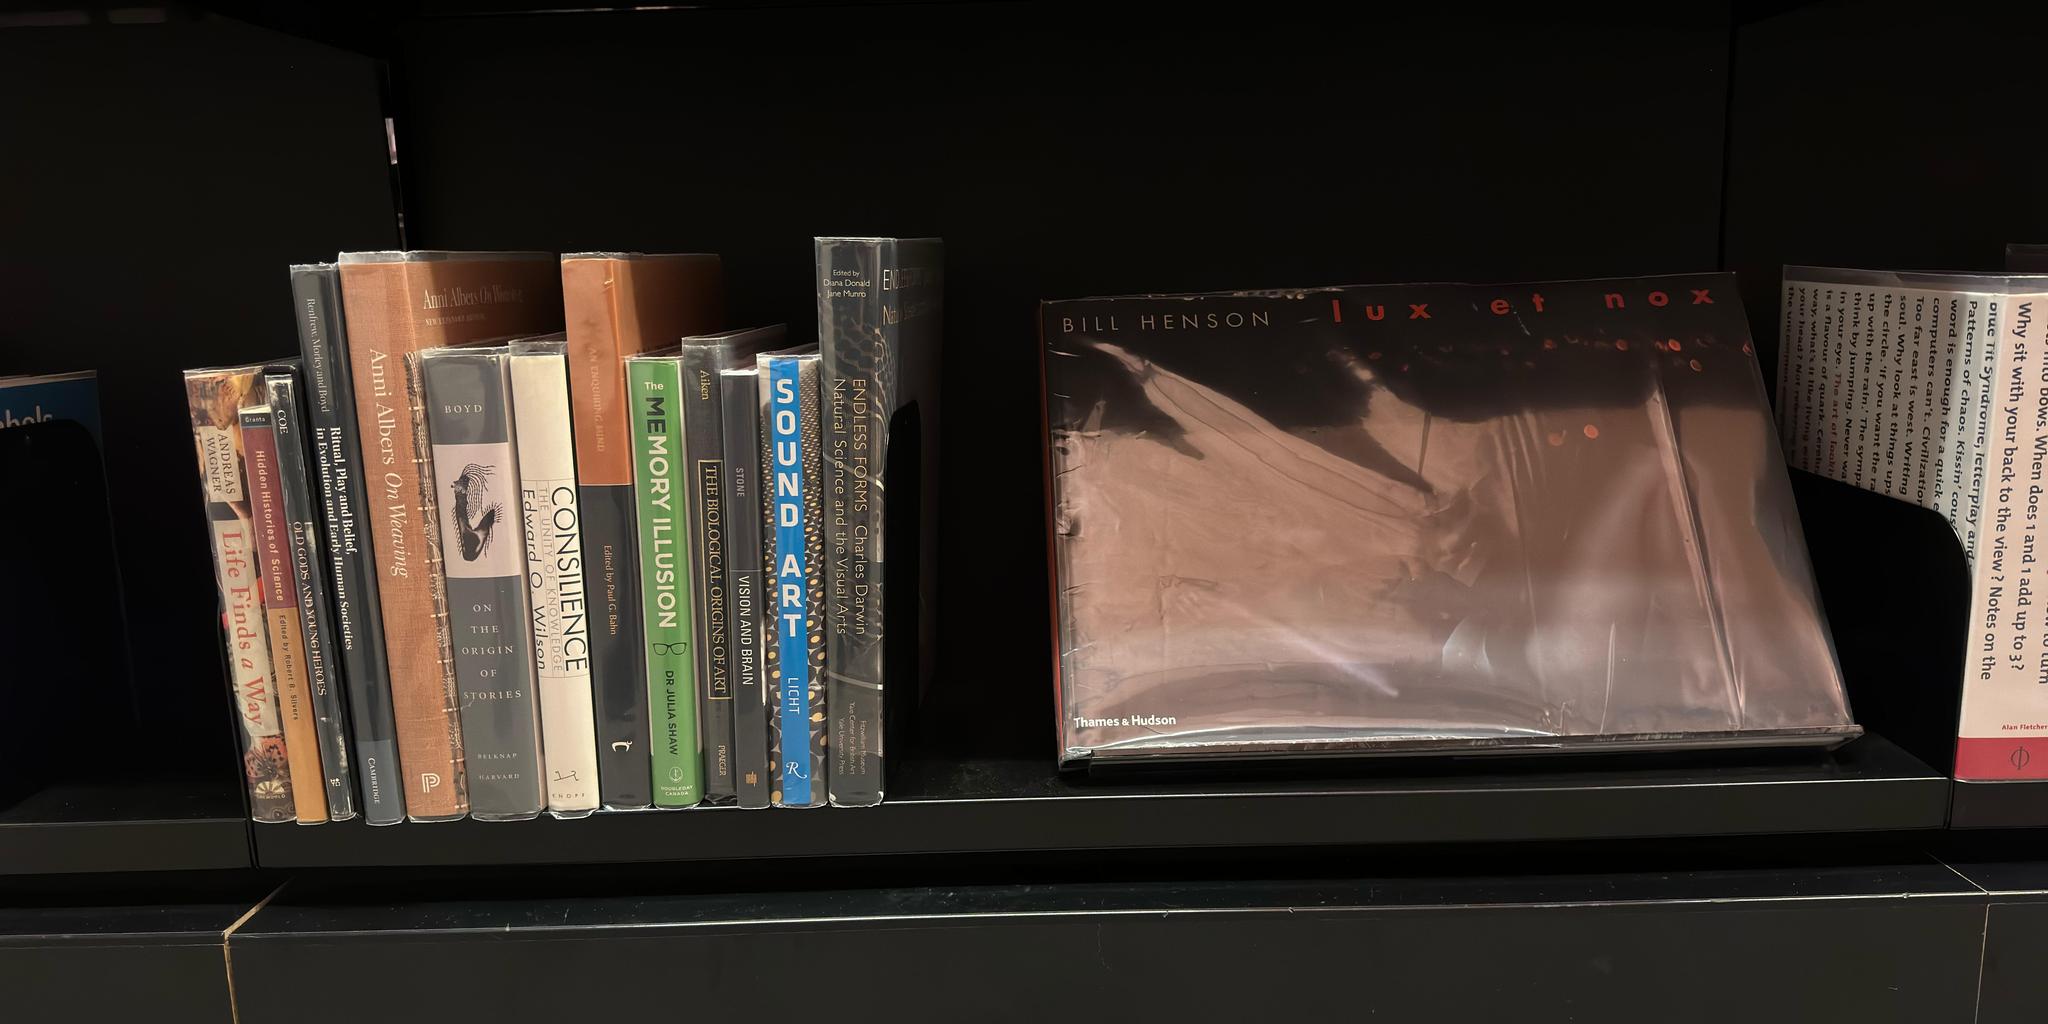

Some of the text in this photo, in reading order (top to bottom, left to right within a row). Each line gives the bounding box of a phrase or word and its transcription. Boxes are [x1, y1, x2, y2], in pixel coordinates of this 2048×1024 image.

[824, 279, 870, 287] Diana Donald
[852, 270, 860, 278] by
[424, 287, 478, 310] Anni Albers
[827, 290, 866, 298] Jane Munro
[1330, 287, 1714, 323] lux et nox
[1063, 312, 1270, 333] BILL HENSON
[1928, 298, 1940, 377] computers
[312, 339, 330, 412] Morley and Boyd
[644, 382, 664, 390] The
[700, 370, 711, 400] Aiken
[1958, 301, 1978, 436] Patterns of chaos.
[444, 404, 482, 414] BOYD
[1900, 296, 1924, 496] Too far east is west. Writing
[1934, 299, 1958, 499] word is enough for a quick
[277, 409, 288, 434] COE
[206, 437, 223, 492] WAGNER
[218, 434, 236, 495] ANDREAS
[370, 349, 408, 578] Anni Albers On Weaving
[1966, 366, 1994, 560] Syndrome, letterplay and
[330, 427, 358, 554] Ritual, Play and Belief,
[736, 467, 745, 498] STONE
[1980, 302, 2032, 680] Why sit with your back to the Notes on the
[646, 397, 677, 628] MEMORY ILLUSION
[776, 378, 805, 638] SOUND ART
[833, 378, 848, 634] Natural Science and the Visual Arts
[852, 380, 868, 635] ENDLESS FORMS Charles Darwin
[2026, 484, 2044, 519] does
[255, 450, 285, 602] Hidden Histories of Science
[316, 428, 354, 650] in Evolution and Early Human Societies
[2026, 522, 2036, 530] 1
[2022, 535, 2036, 564] and
[522, 490, 548, 670] Edward O. Wilson
[538, 488, 562, 672] THE UNITY OF KNOWLEDGE
[552, 486, 588, 672] CONSILIENCE
[604, 545, 618, 634] Edited by Paul G. Bahn
[705, 466, 726, 694] THE BIOLOGICAL ORIGINS OF ART
[2021, 568, 2031, 576] 1
[294, 522, 328, 696] OLD GODS AND YOUNG HEROES
[472, 604, 492, 612] ON
[2017, 578, 2032, 608] add
[222, 532, 266, 728] Life Finds a Way
[279, 615, 288, 642] Edited
[470, 626, 499, 634] THE
[738, 575, 754, 686] VISION AND BRAIN
[2012, 610, 2027, 631] up
[283, 642, 290, 652] by
[462, 646, 513, 655] ORIGIN
[2013, 634, 2026, 651] to
[284, 654, 294, 682] Robert
[480, 669, 498, 678] OF
[290, 694, 300, 721] Silvers
[464, 690, 522, 700] STORIES
[788, 678, 800, 714] LICHT
[666, 670, 678, 756] DR JULIA SHAW
[1074, 714, 1177, 729] Thames & Hudson
[478, 752, 518, 760] BELKNAP
[718, 745, 726, 776] PRAEGER
[367, 758, 380, 804] CAMBRIDGE
